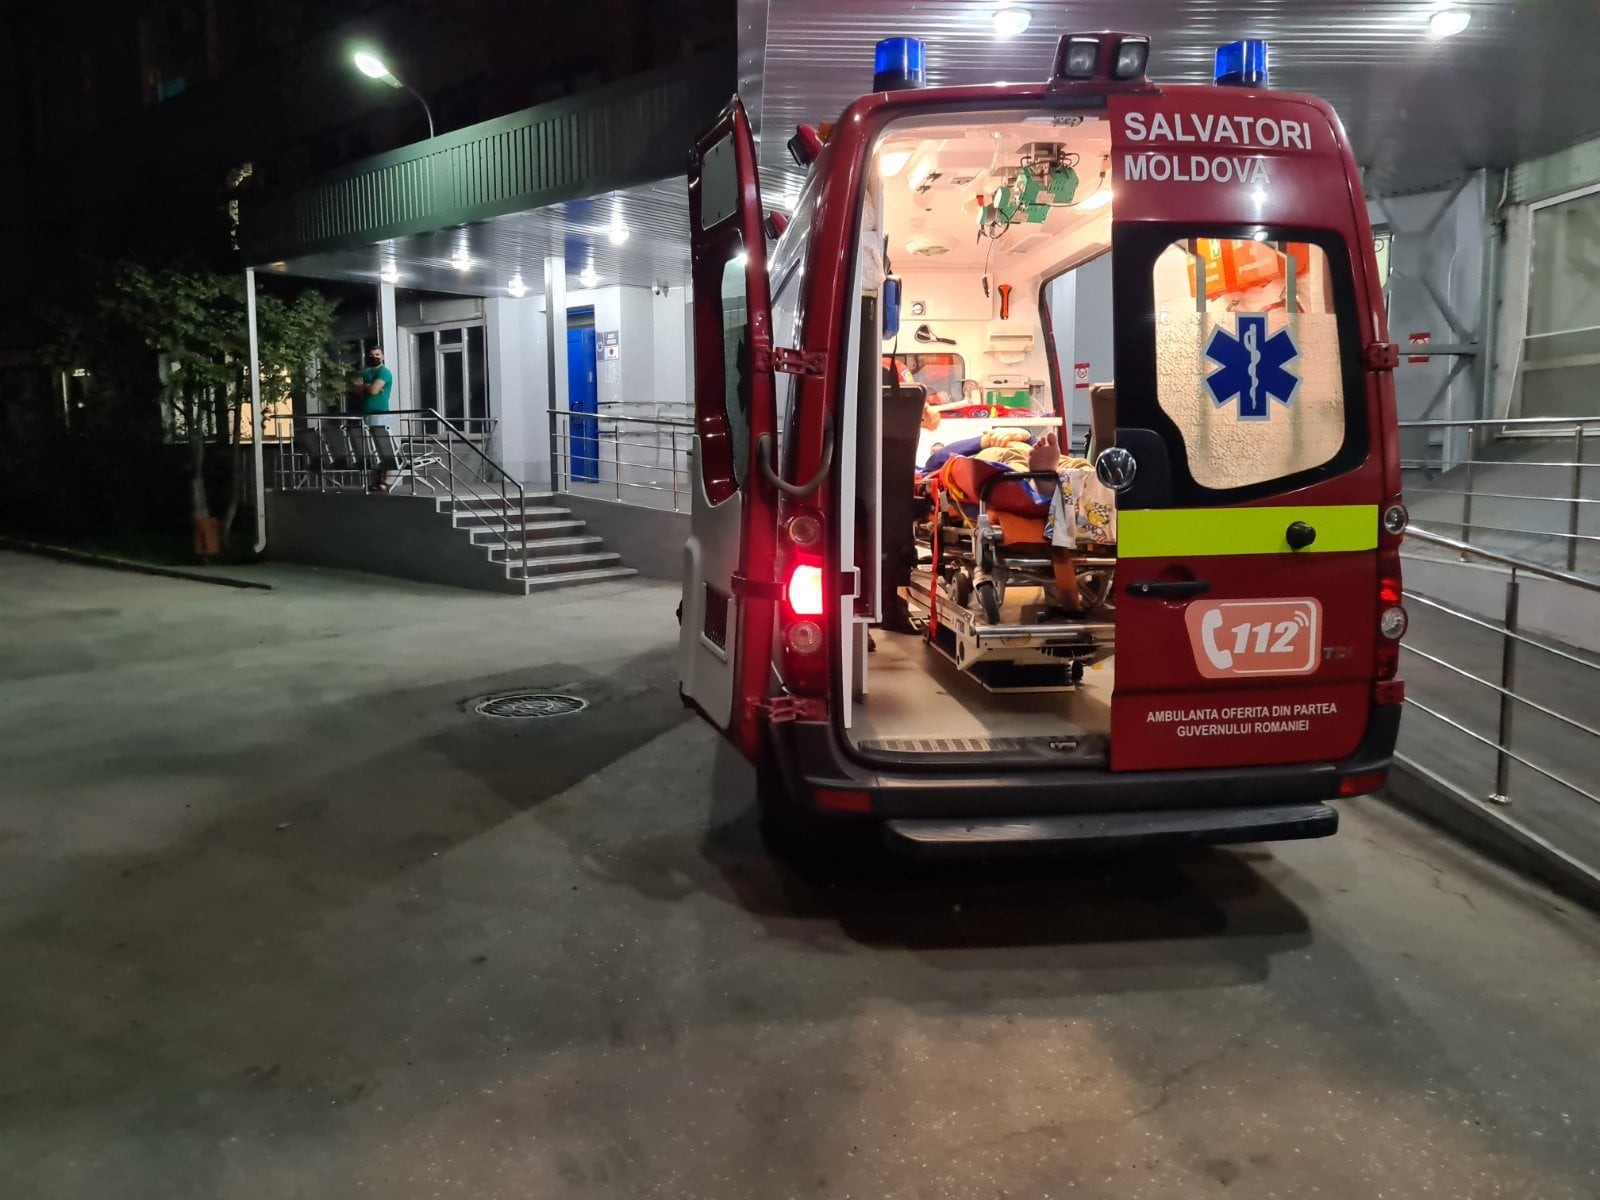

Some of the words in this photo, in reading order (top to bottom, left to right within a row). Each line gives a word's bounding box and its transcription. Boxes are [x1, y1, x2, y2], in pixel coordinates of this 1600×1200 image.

[1124, 111, 1312, 150] SALVATORI
[1124, 155, 1271, 184] MOLDOVA
[1231, 621, 1300, 654] 112
[1146, 708, 1218, 723] AMBULANTA
[1221, 706, 1270, 720] OFERITA
[1272, 705, 1291, 717] DIN
[1294, 702, 1338, 716] PARTEA
[1177, 722, 1252, 737] GUVERNULUI
[1255, 720, 1309, 733] ROMANIEI
